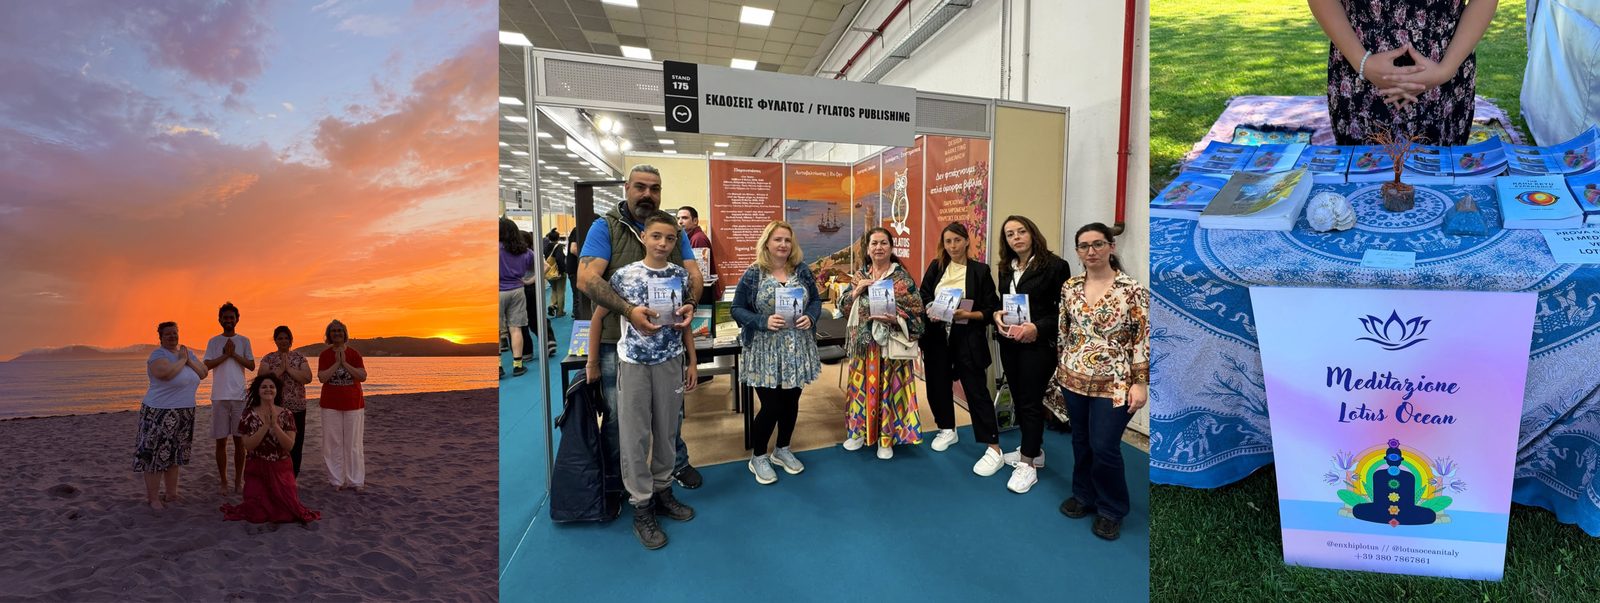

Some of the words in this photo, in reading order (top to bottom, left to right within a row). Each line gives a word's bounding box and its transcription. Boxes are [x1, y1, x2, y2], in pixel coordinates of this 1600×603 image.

[672, 82, 689, 90] 175
[706, 94, 753, 109] ΕΚΔΟΣΕΙΣ
[757, 98, 804, 114] ΦΥΛΑΤΟΣ
[817, 104, 855, 118] FYLATOS
[859, 108, 910, 122] PUBLISHING
[892, 237, 910, 248] YLATOS
[1326, 366, 1460, 400] Meditazione
[1338, 401, 1388, 424] Lotus
[1395, 401, 1457, 425] Ocean
[1326, 540, 1379, 551] @enxhiplotus
[1392, 544, 1460, 557] @lotusoceanitaly
[1375, 554, 1392, 562] 380
[1394, 555, 1431, 565] 7867861
